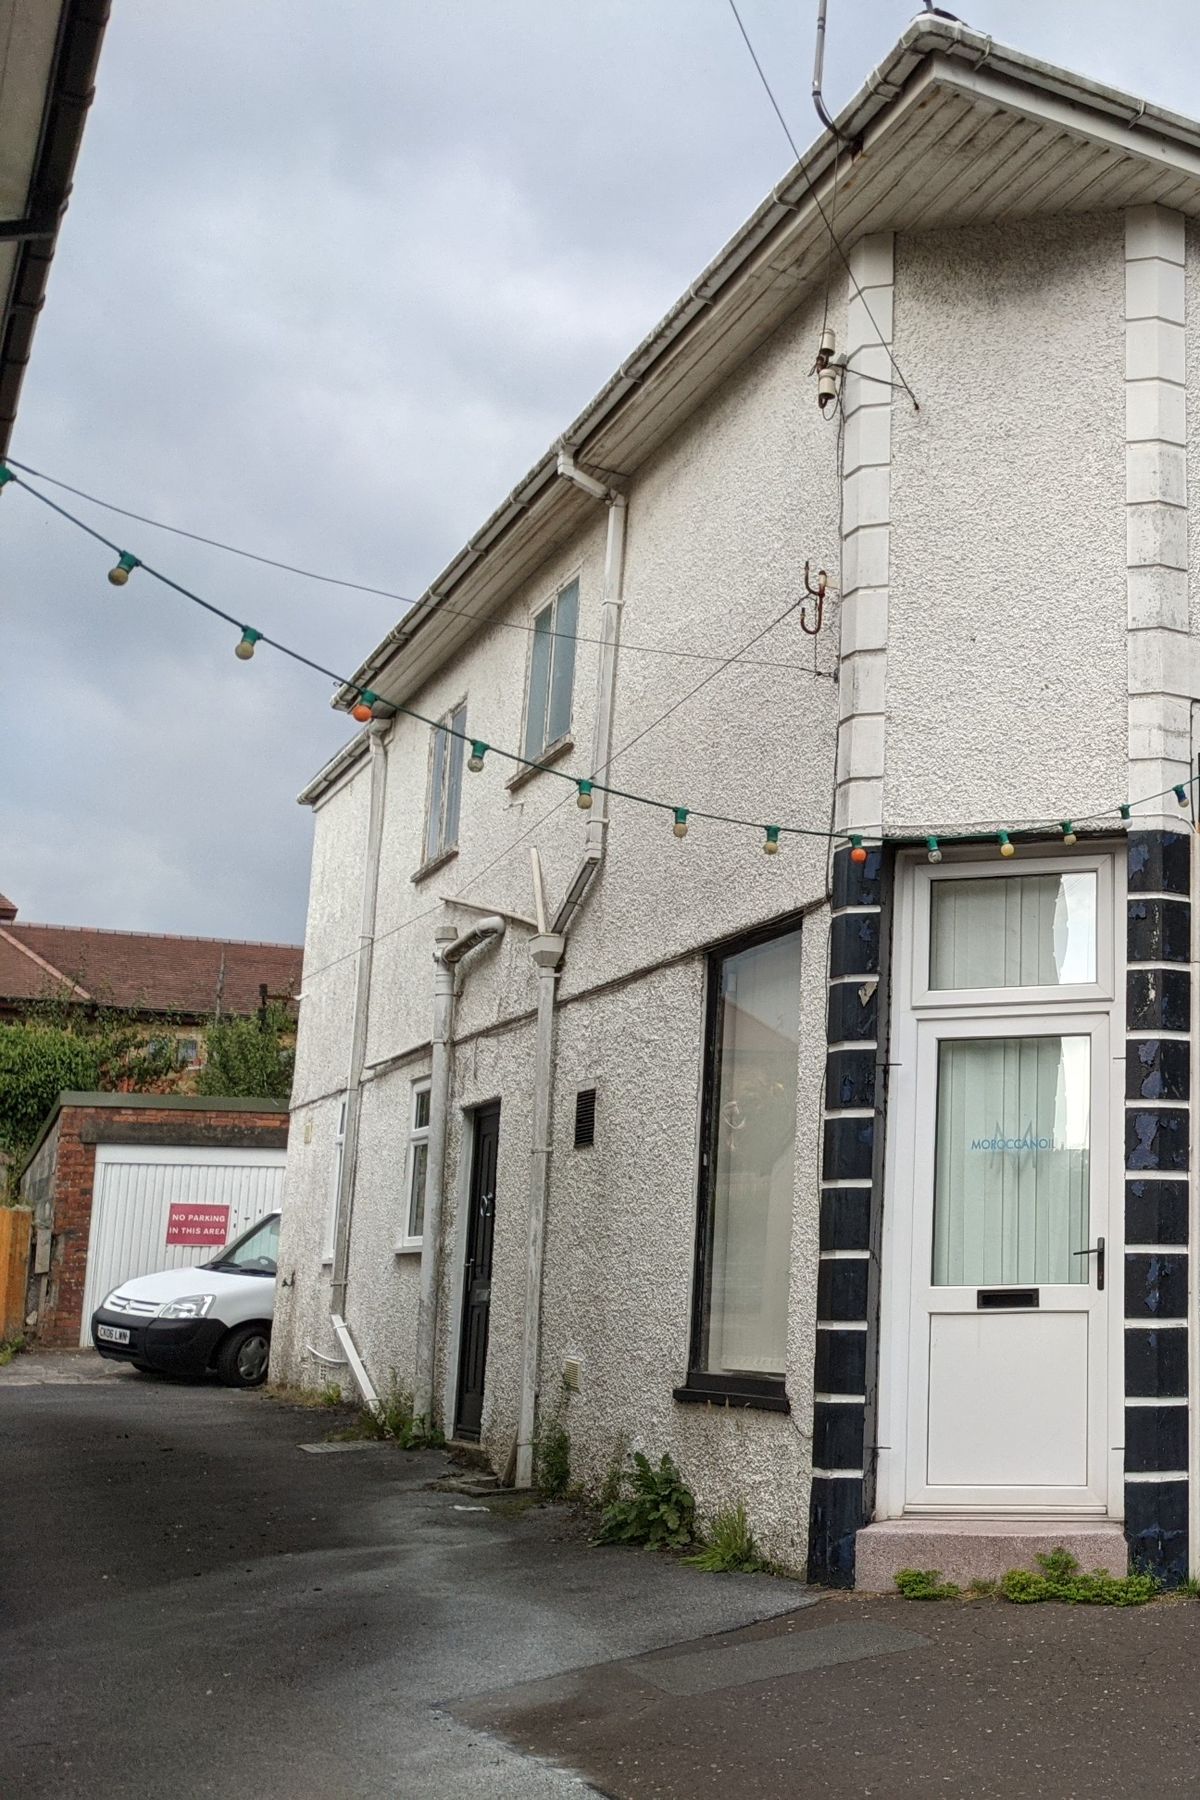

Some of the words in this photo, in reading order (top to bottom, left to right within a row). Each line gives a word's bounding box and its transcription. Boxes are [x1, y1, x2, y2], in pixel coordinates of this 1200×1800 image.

[188, 1214, 226, 1223] PARKING
[169, 1226, 179, 1234] IN
[181, 1227, 201, 1235] THIS
[203, 1228, 226, 1236] AREA
